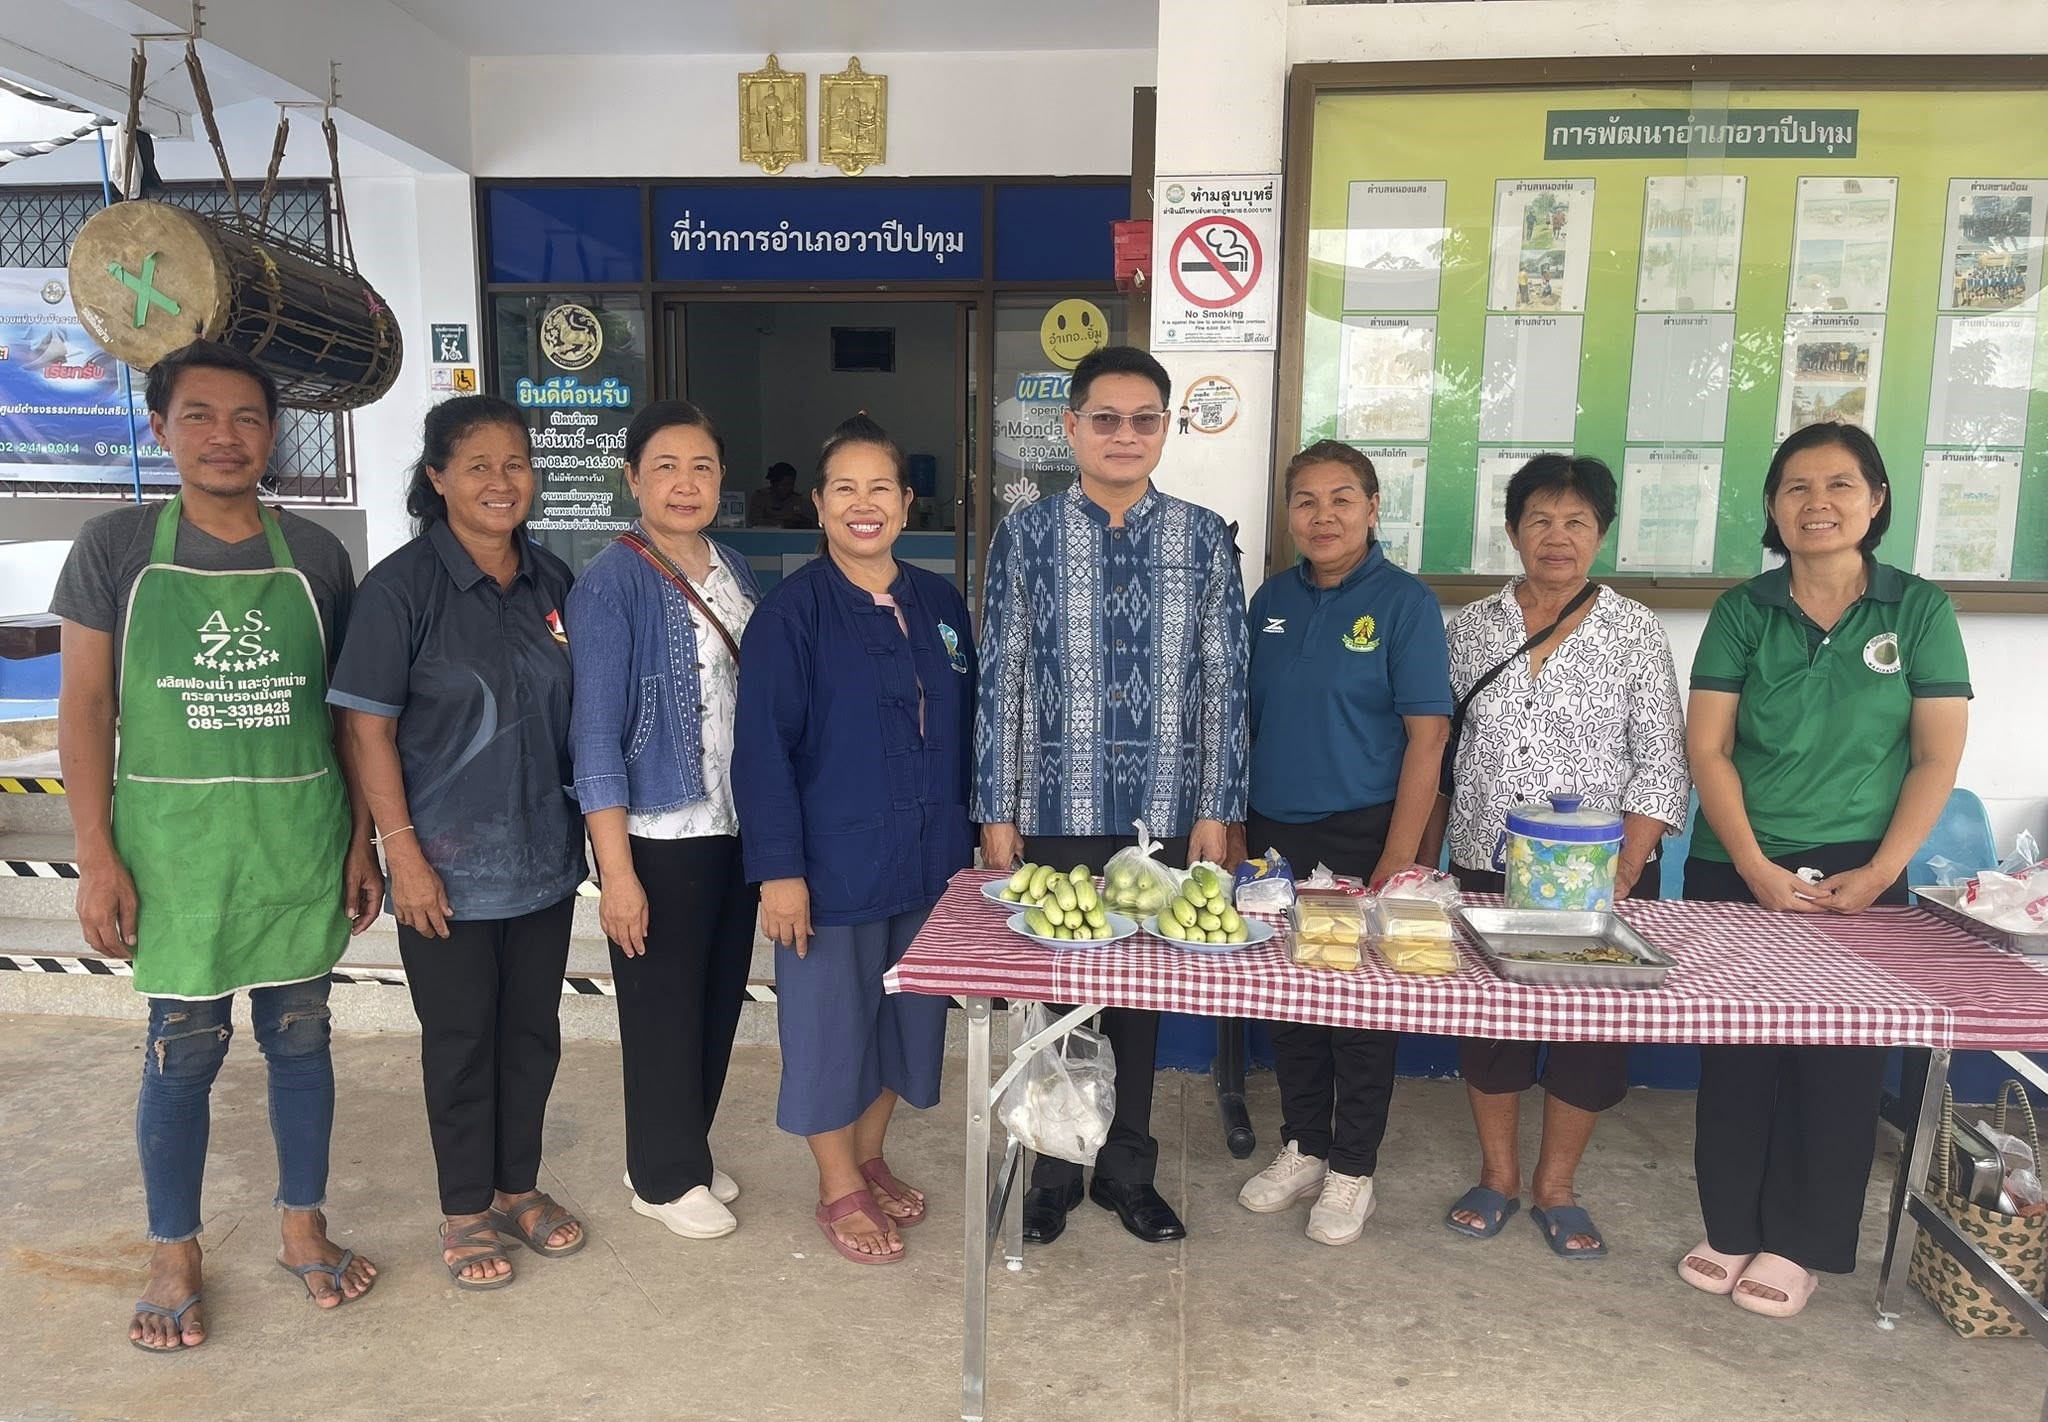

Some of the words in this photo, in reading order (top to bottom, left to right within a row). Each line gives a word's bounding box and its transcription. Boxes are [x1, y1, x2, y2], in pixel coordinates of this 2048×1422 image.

[1551, 115, 1852, 153] การพัฒนาอำเภอวาปีปทุม
[1190, 182, 1273, 207] ห้ามสูบบุหรี่
[670, 210, 964, 264] ที่ว่าการอำเภอวาปีปทุม
[1185, 310, 1198, 319] No
[1202, 310, 1244, 319] Smoking
[44, 362, 104, 379] เรียกรับ
[519, 379, 628, 405] ยินดีต้อนรับ
[551, 411, 598, 425] เปิดบริการ
[1031, 407, 1057, 418] open
[1007, 420, 1067, 438] Monda
[596, 428, 627, 454] ศุกร์
[1047, 446, 1069, 458] AM
[544, 502, 611, 516] งานทะเบียนทั่วไป
[197, 609, 271, 632] A.S.
[156, 675, 234, 690] ผลิตฟองน้ำ
[238, 672, 306, 689] และจำหน่าย
[181, 688, 292, 702] กระดาษรองมังคุด
[186, 701, 290, 717] 081-3318428
[188, 715, 291, 730] 085-1978111
